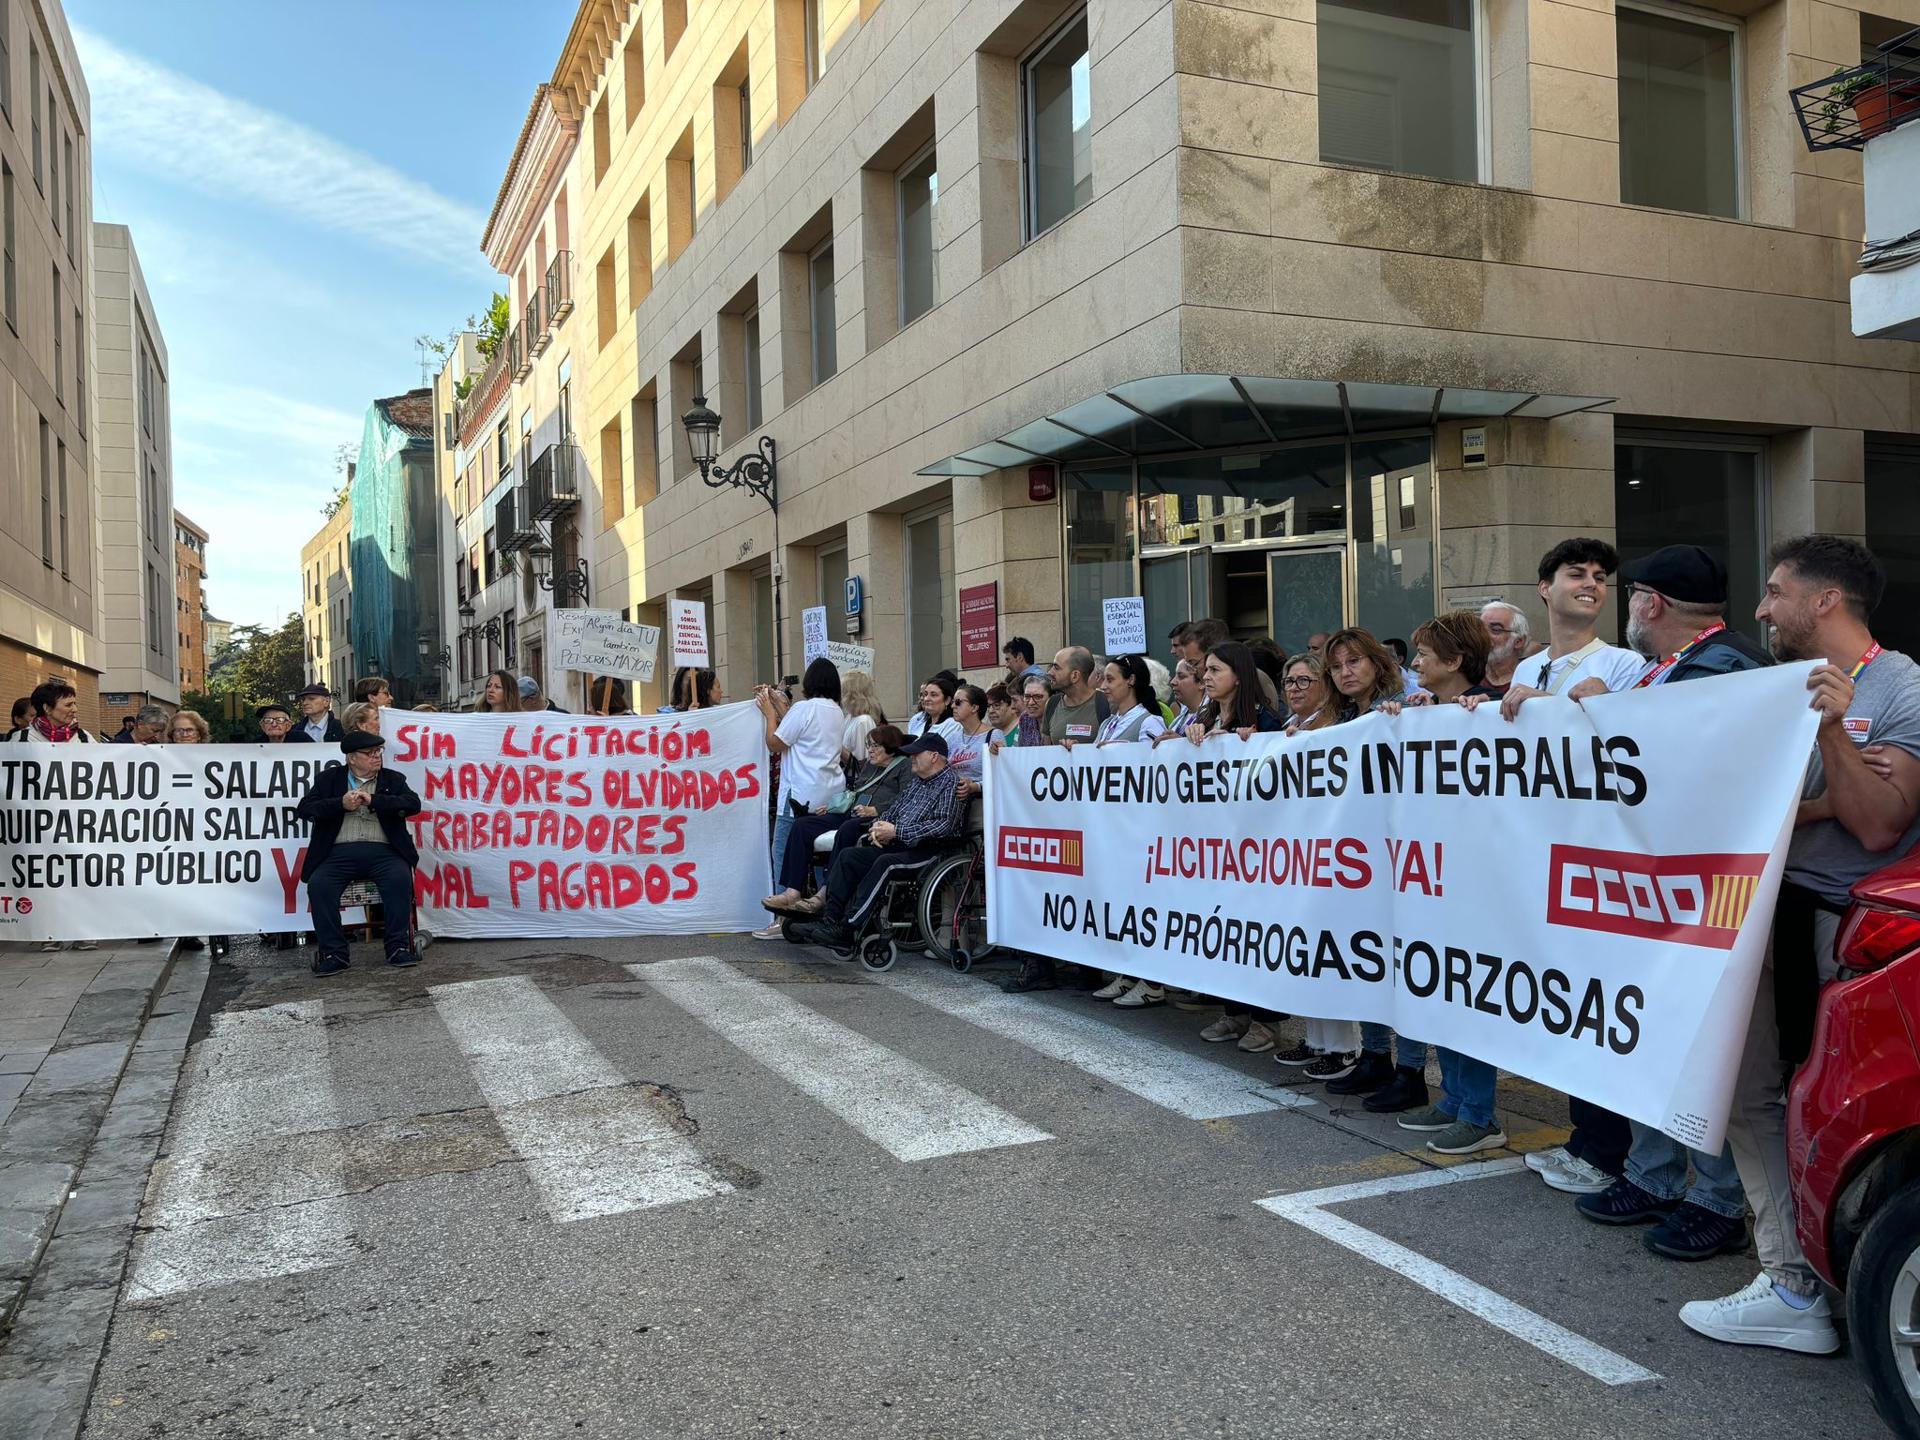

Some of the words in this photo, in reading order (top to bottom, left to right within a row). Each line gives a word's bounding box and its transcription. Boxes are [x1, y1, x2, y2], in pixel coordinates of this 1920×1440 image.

[847, 580, 856, 611] P
[1105, 601, 1142, 612] PERSONAL
[612, 653, 653, 673] MAYOR
[2, 761, 160, 801] TRABAJO
[425, 762, 593, 808] MAYORES
[1030, 765, 1169, 803] CONVENIO
[1175, 746, 1348, 803] GESTIONES
[1361, 735, 1648, 807] INTEGRALES
[407, 809, 688, 856] TRABAJADORES
[1004, 834, 1060, 864] CCOO
[11, 853, 125, 889] SECTOR
[135, 846, 262, 886] PÚBLICO
[413, 862, 489, 910] MAL
[510, 860, 699, 911] PAGADOS
[1145, 836, 1373, 890] ¡LICITACIONES
[1384, 838, 1444, 897] YA!
[1560, 862, 1705, 926] CCOO
[1043, 892, 1077, 932] NO
[1082, 899, 1099, 937] A
[1104, 902, 1158, 949] LAS
[1164, 905, 1386, 983] PRÓRROGAS
[1393, 936, 1644, 1056] FORZOSAS
